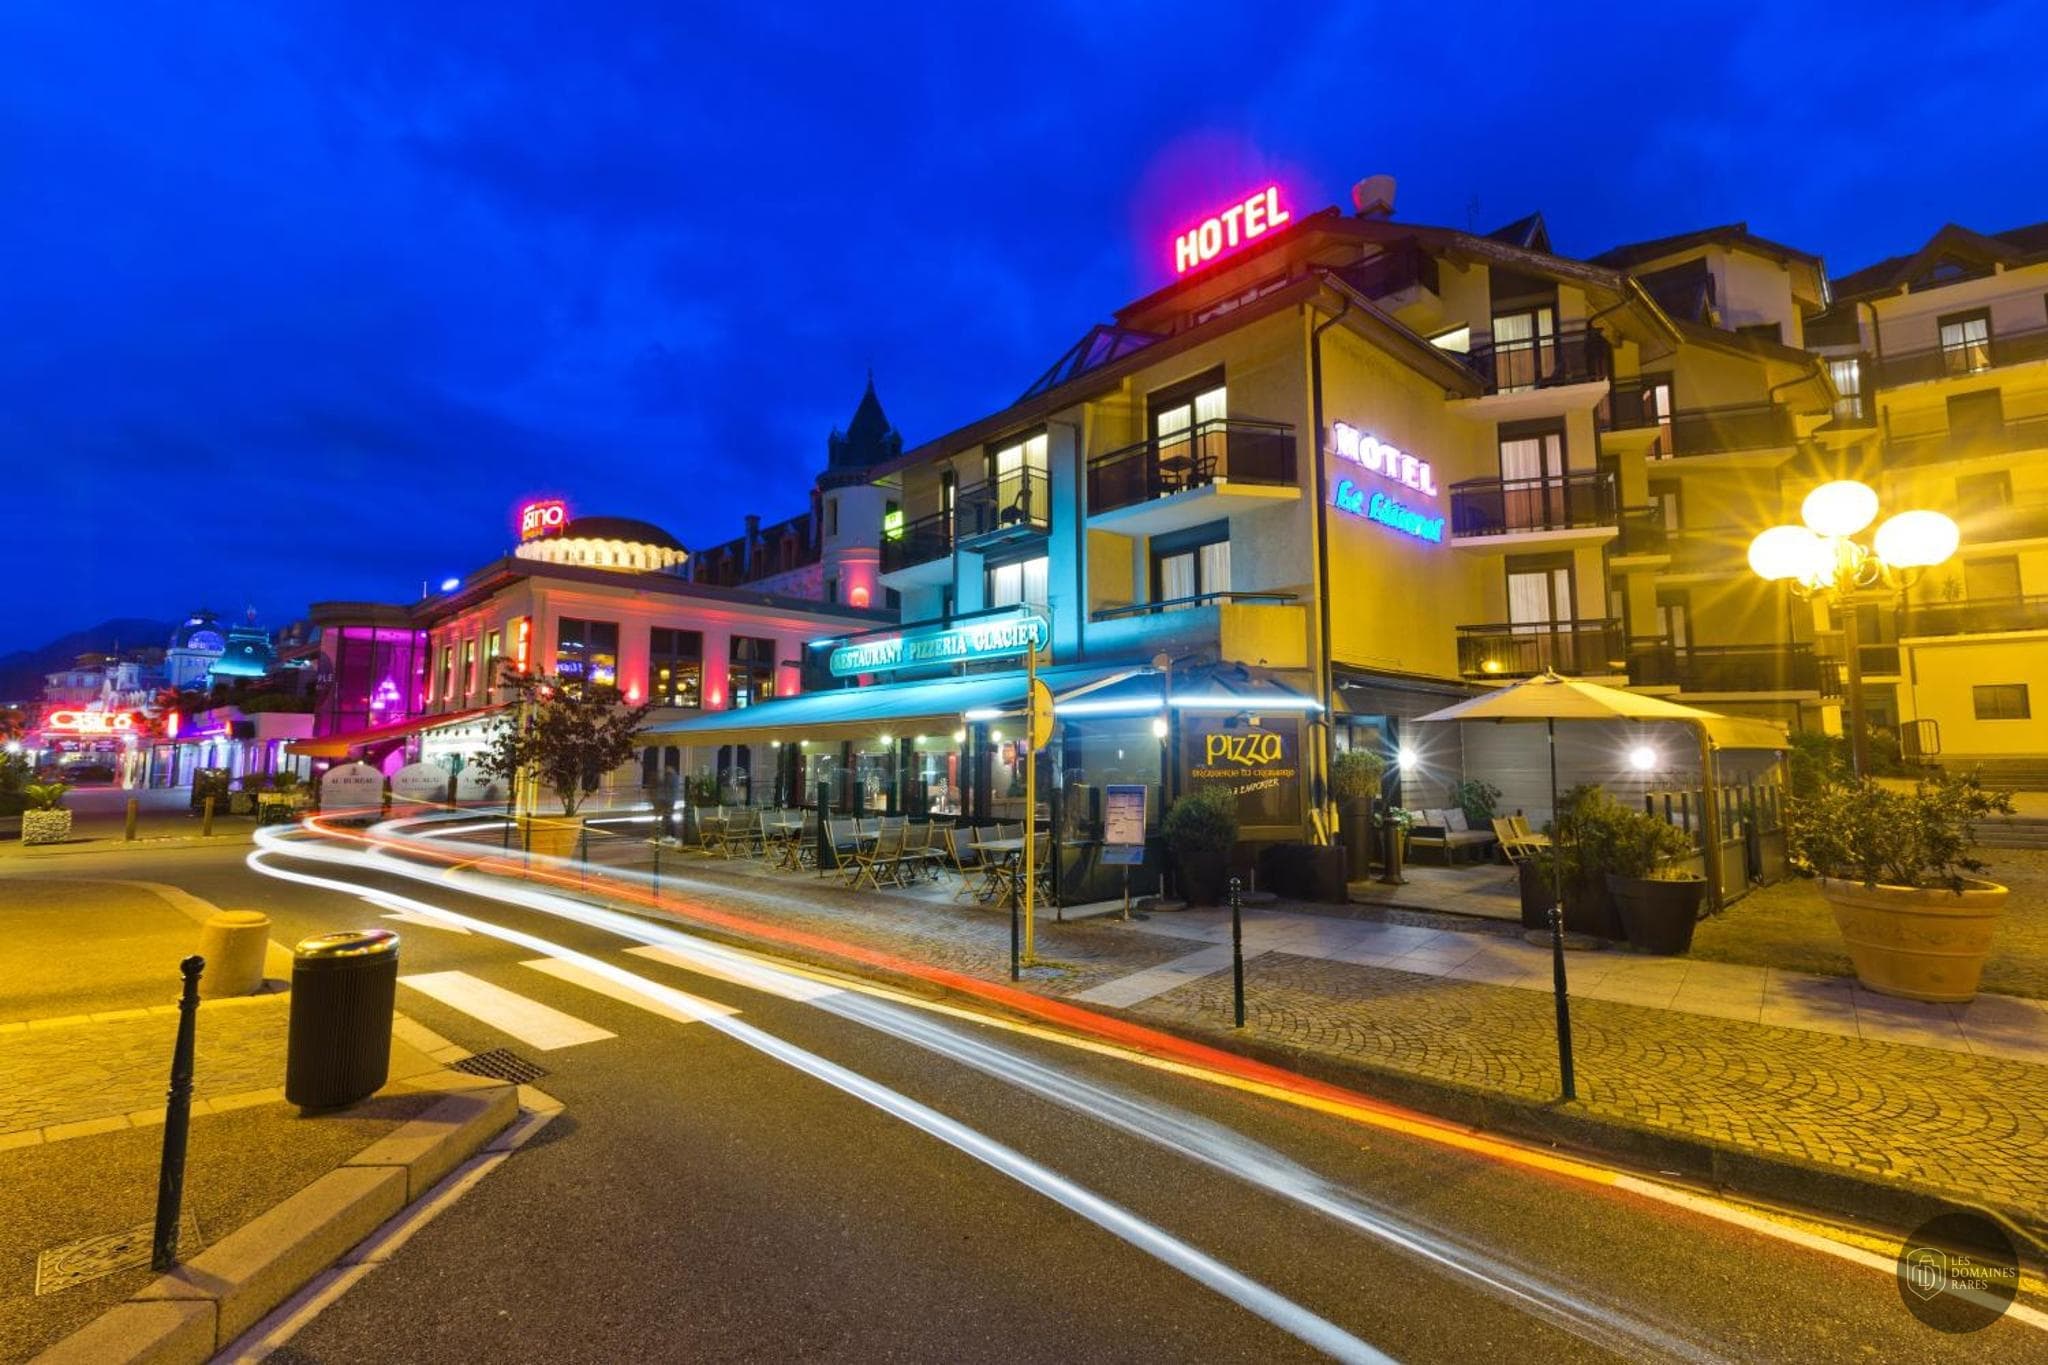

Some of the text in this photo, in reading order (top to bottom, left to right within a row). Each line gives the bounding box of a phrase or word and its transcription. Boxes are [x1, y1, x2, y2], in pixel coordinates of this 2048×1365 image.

[1176, 186, 1290, 273] HOTEL
[834, 622, 1040, 671] RESTAURANT PIZZERIA GLACIER
